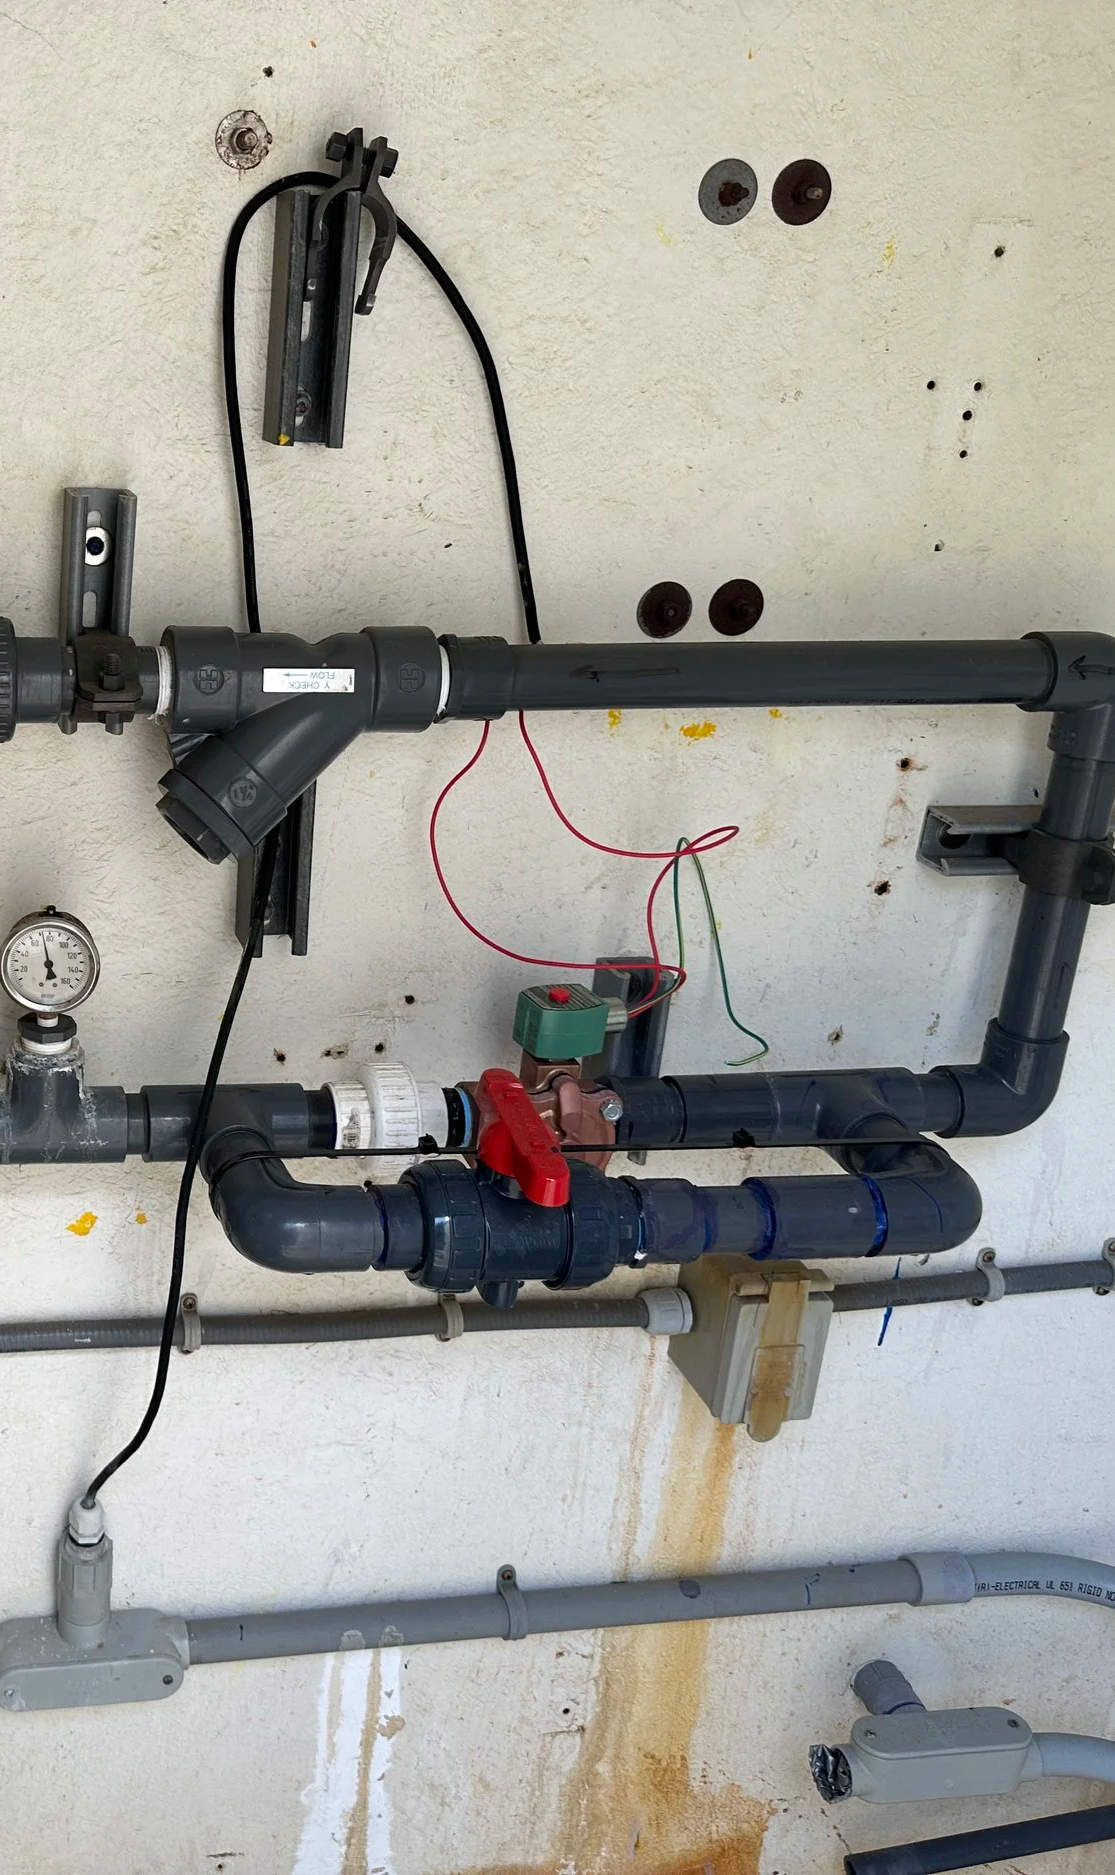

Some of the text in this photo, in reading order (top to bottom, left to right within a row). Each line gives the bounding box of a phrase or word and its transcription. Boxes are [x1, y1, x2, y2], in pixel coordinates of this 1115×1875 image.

[309, 672, 335, 680] FLOW
[31, 939, 39, 947] 60
[46, 935, 54, 943] 80
[59, 941, 69, 949] 100
[20, 965, 28, 973] 20
[68, 966, 79, 974] 140
[60, 977, 71, 985] 160
[1060, 1580, 1073, 1591] 651
[1077, 1582, 1103, 1597] RIGID
